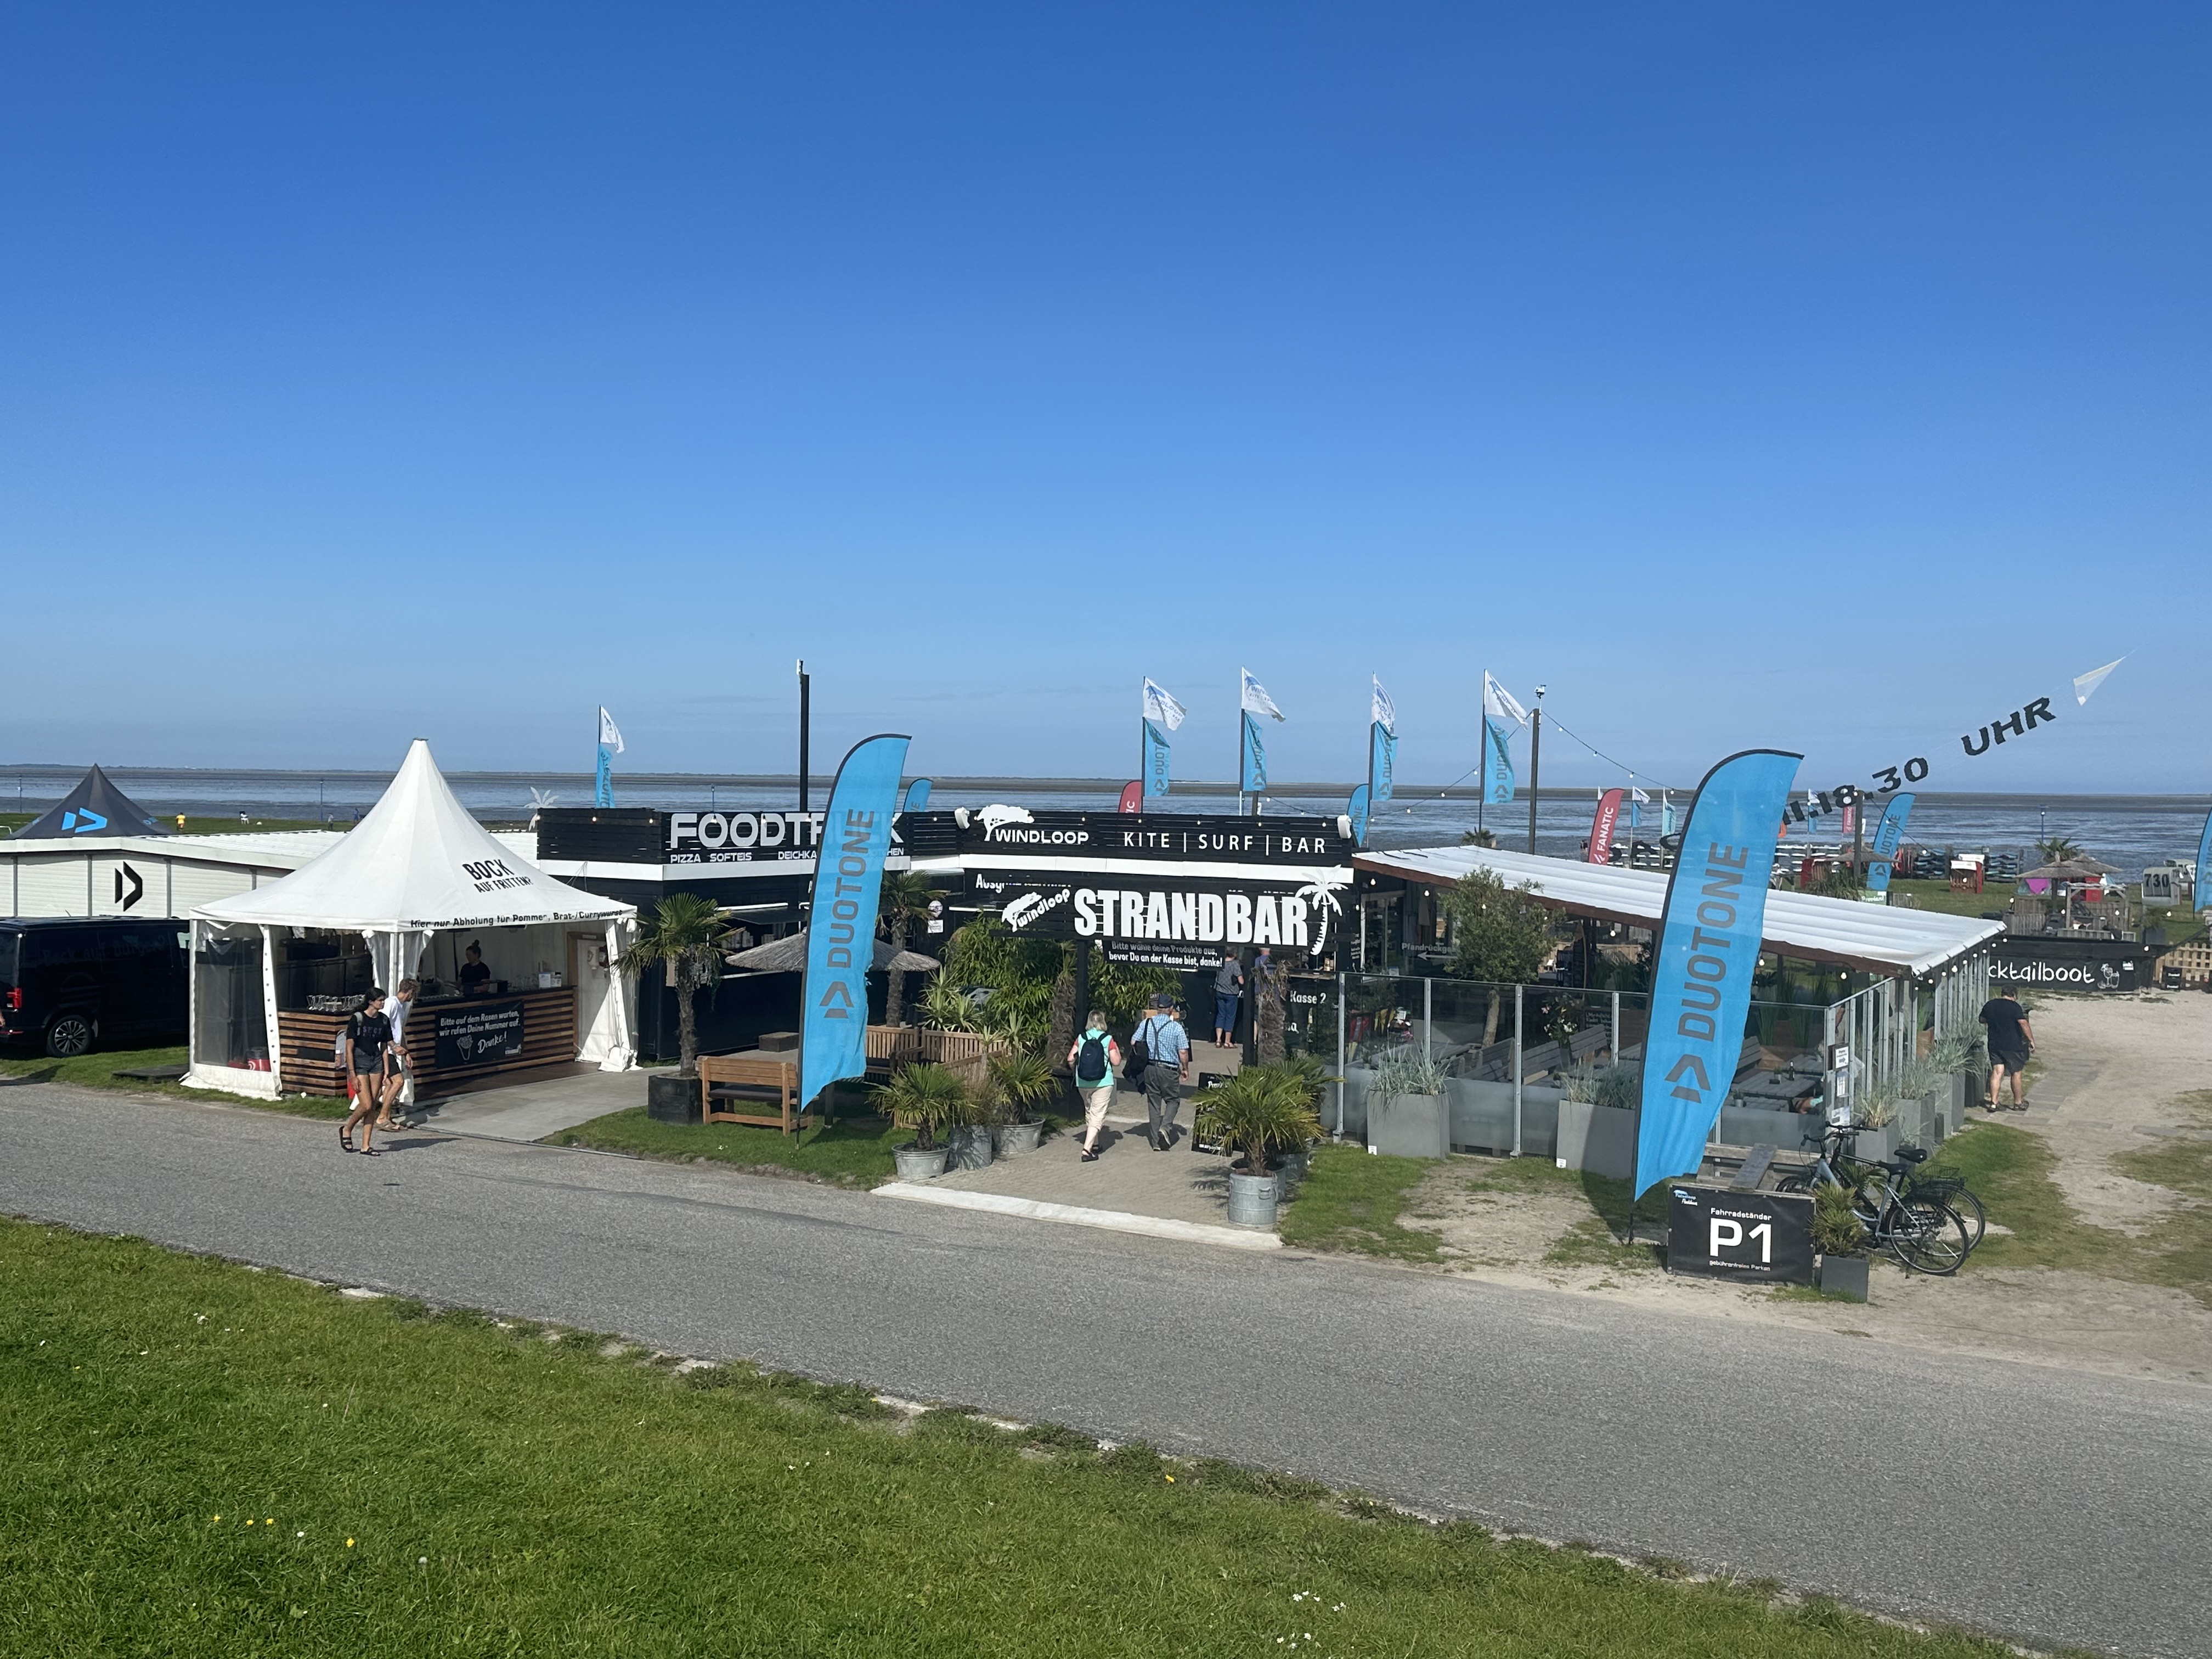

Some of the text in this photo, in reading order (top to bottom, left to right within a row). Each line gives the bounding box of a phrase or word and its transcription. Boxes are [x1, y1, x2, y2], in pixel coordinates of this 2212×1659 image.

[1961, 696, 2057, 756] UHR
[995, 829, 1089, 844] WINDLOOP
[1597, 806, 1613, 852] FANATIC
[1124, 832, 1325, 854] KITE SURF BAR
[670, 854, 701, 864] PIZZA
[709, 852, 752, 862] SOFTEIS
[462, 859, 515, 881] BOCK
[474, 876, 534, 893] AUF FRITTEN?
[827, 809, 875, 969] DUOTONE
[2144, 873, 2169, 888] 730
[411, 919, 431, 928] Hier
[453, 917, 494, 926] Abholung
[1074, 888, 1308, 947] STRANDBAR
[1111, 941, 1129, 951] Bitte
[1171, 945, 1202, 955] Produkte
[1677, 842, 1749, 1042] DUOTONE
[1108, 951, 1129, 961] bevor
[1130, 952, 1139, 961] Du
[1150, 953, 1162, 963] der
[1163, 953, 1183, 964] Kasse
[1184, 955, 1199, 967] bist,
[1200, 957, 1223, 968] danke!
[1988, 960, 2096, 984] cktailboot
[1290, 990, 1327, 1005] Kasse 2
[455, 1015, 467, 1025] auf
[439, 1027, 450, 1037] wir
[478, 1031, 507, 1053] Danke!
[1711, 1207, 1772, 1221] Fahrradständer
[1709, 1217, 1771, 1263] P1
